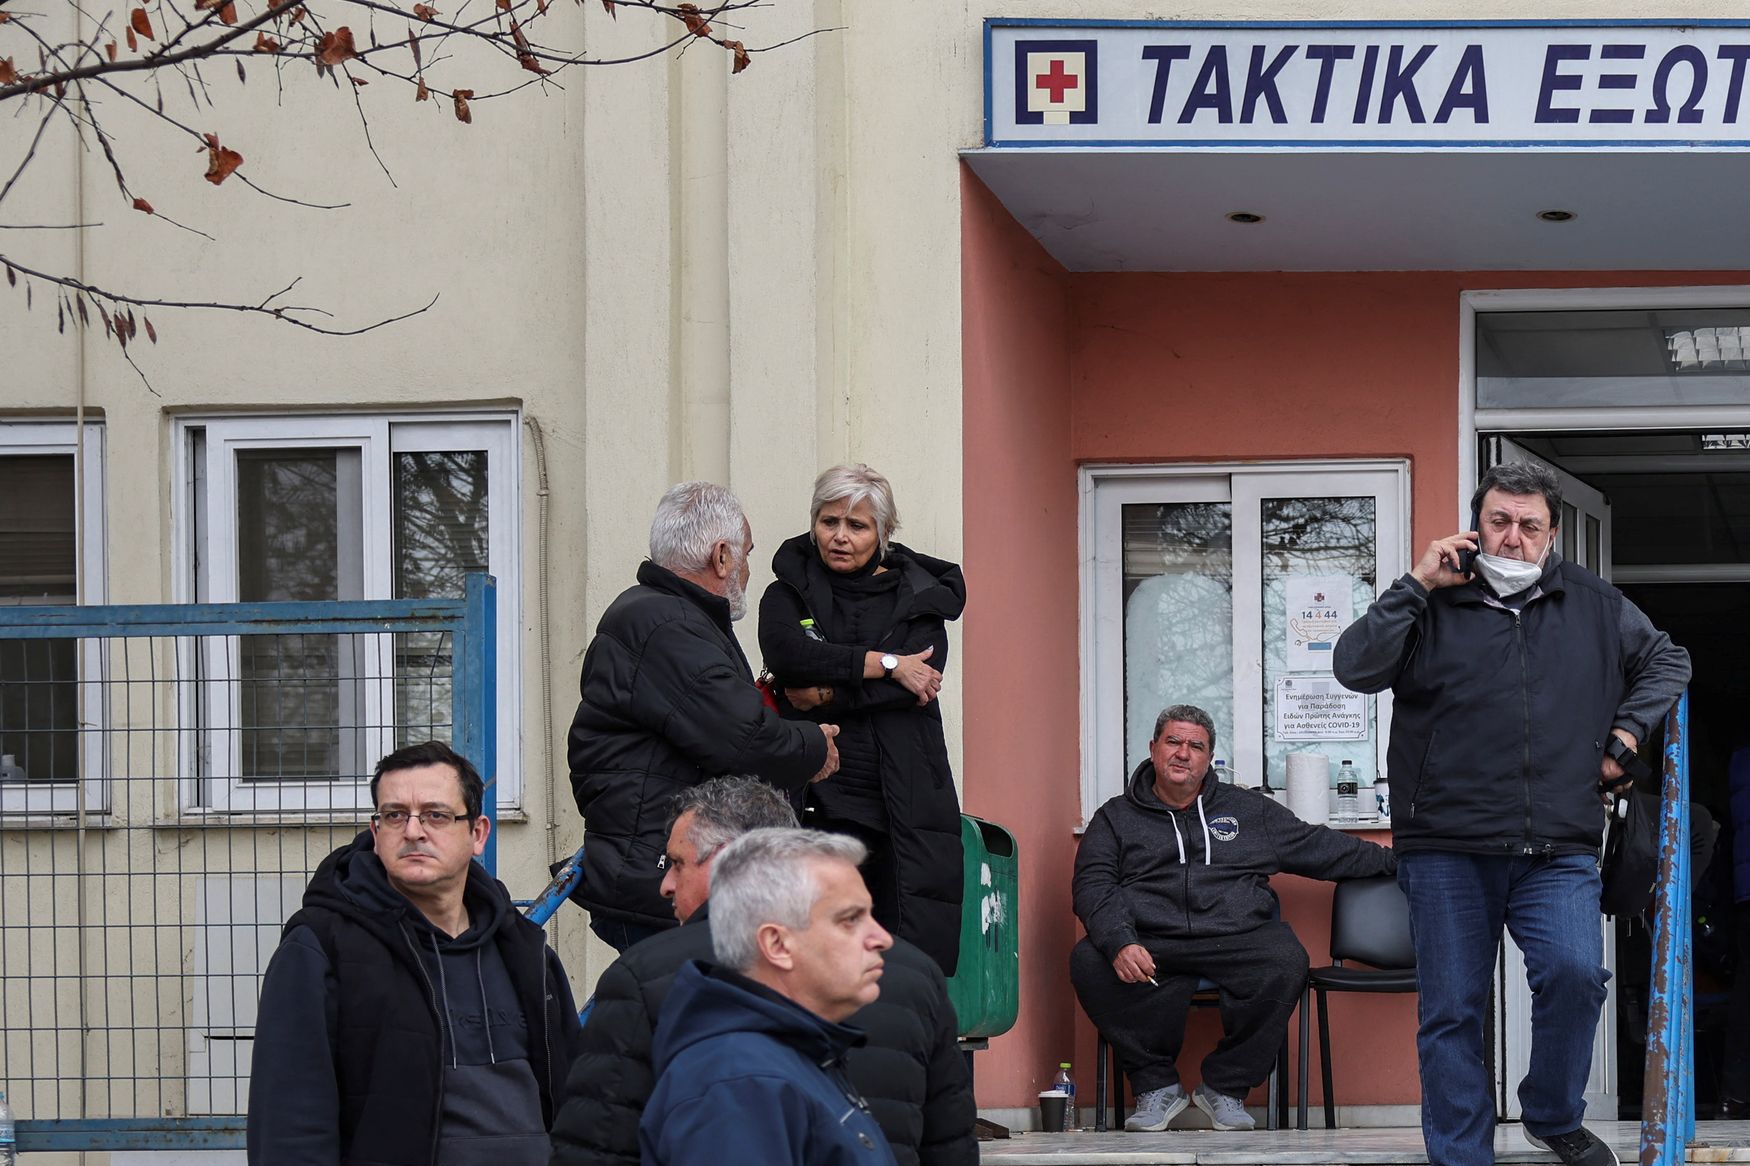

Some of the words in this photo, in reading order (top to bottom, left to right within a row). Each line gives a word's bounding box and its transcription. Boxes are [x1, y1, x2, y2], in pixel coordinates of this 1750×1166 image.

[1141, 44, 1490, 124] ΤΑΚΤΙΚΑ
[1301, 611, 1313, 619] 14
[1324, 610, 1337, 619] 44
[1285, 693, 1325, 701] Ενημέρωση
[1305, 712, 1331, 720] Πρώτης
